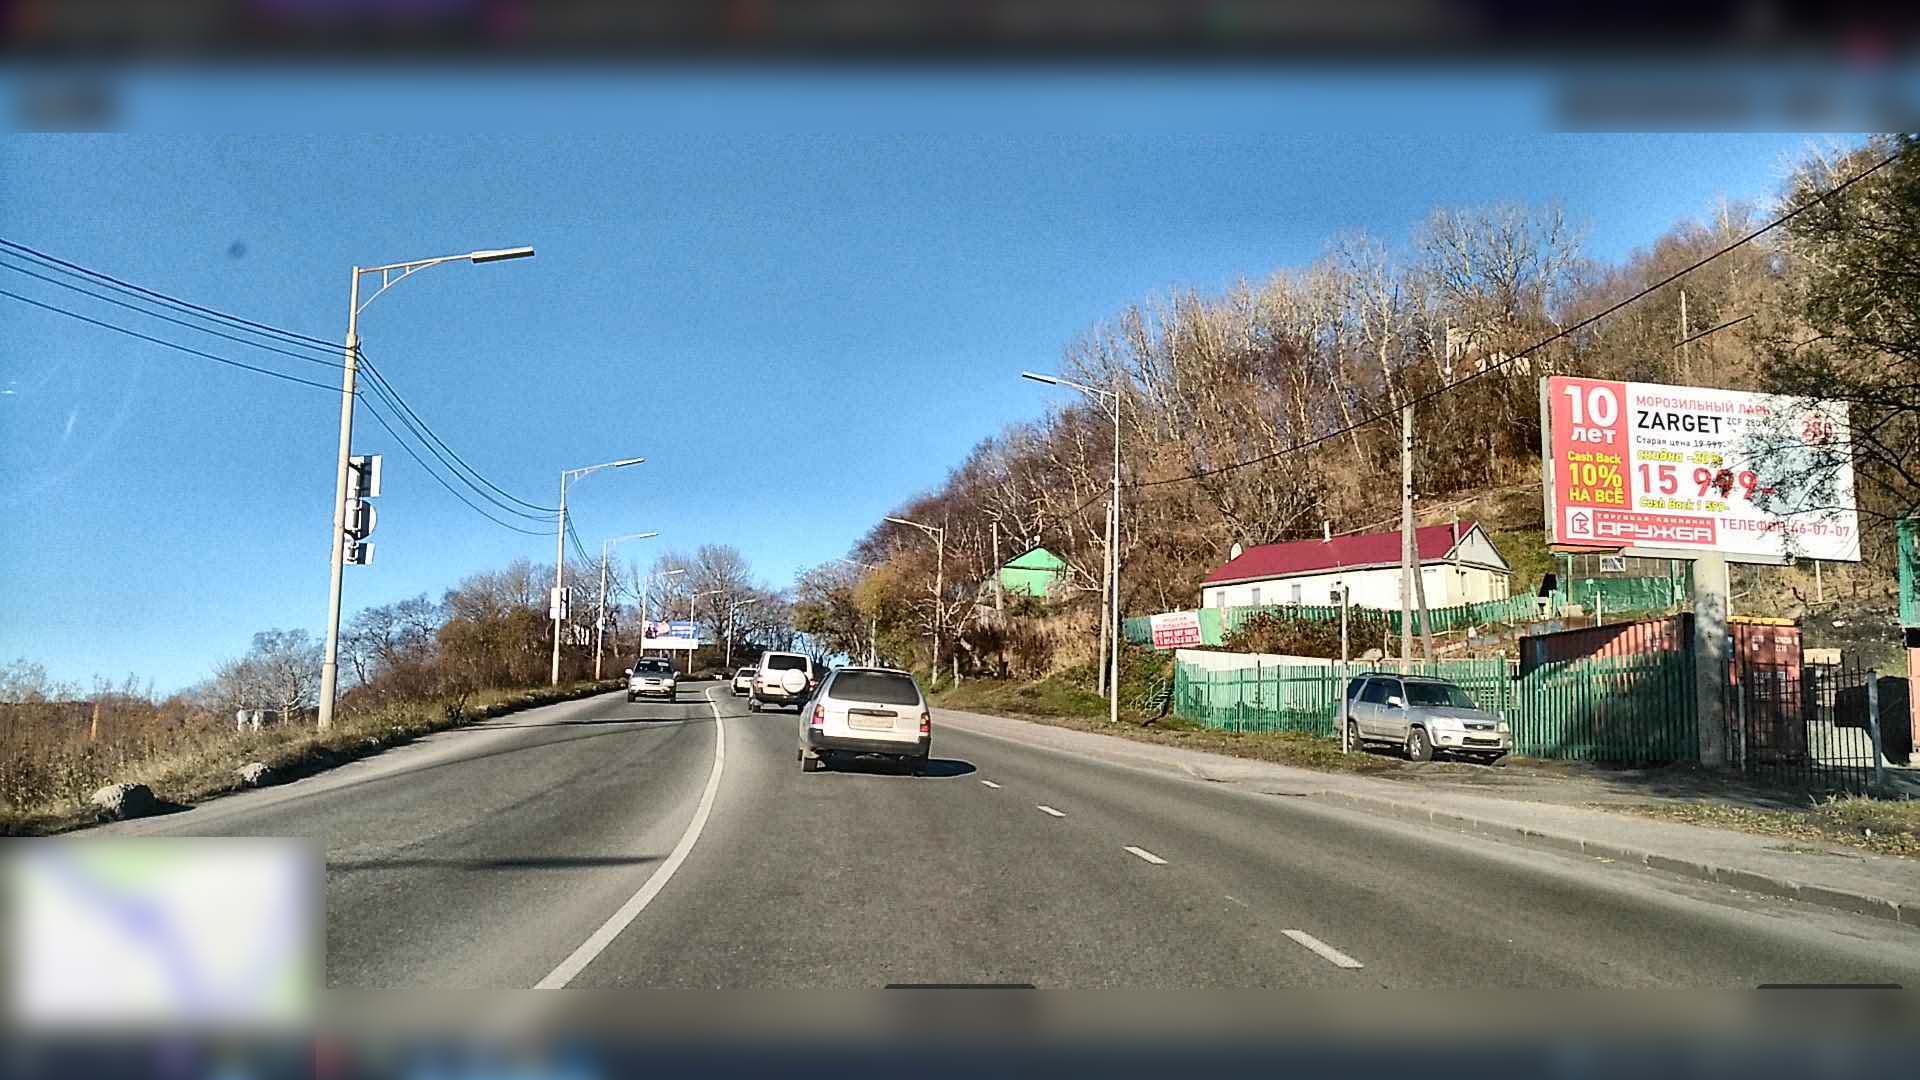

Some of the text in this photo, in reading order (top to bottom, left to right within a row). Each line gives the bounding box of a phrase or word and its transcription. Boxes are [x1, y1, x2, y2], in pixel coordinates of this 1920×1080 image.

[1563, 384, 1618, 427] 10
[1636, 395, 1734, 413] МОРОЗИЛЬНЫЙ
[1637, 410, 1722, 434] ZARGET
[1571, 426, 1616, 444] лет
[1636, 435, 1667, 446] Старая
[1669, 439, 1691, 448] цена
[1568, 450, 1622, 465] Cash Back
[1568, 463, 1623, 488] 10%
[1638, 463, 1678, 495] 15
[1569, 487, 1592, 502] НА
[1598, 521, 1713, 542] ДРУЖБА
